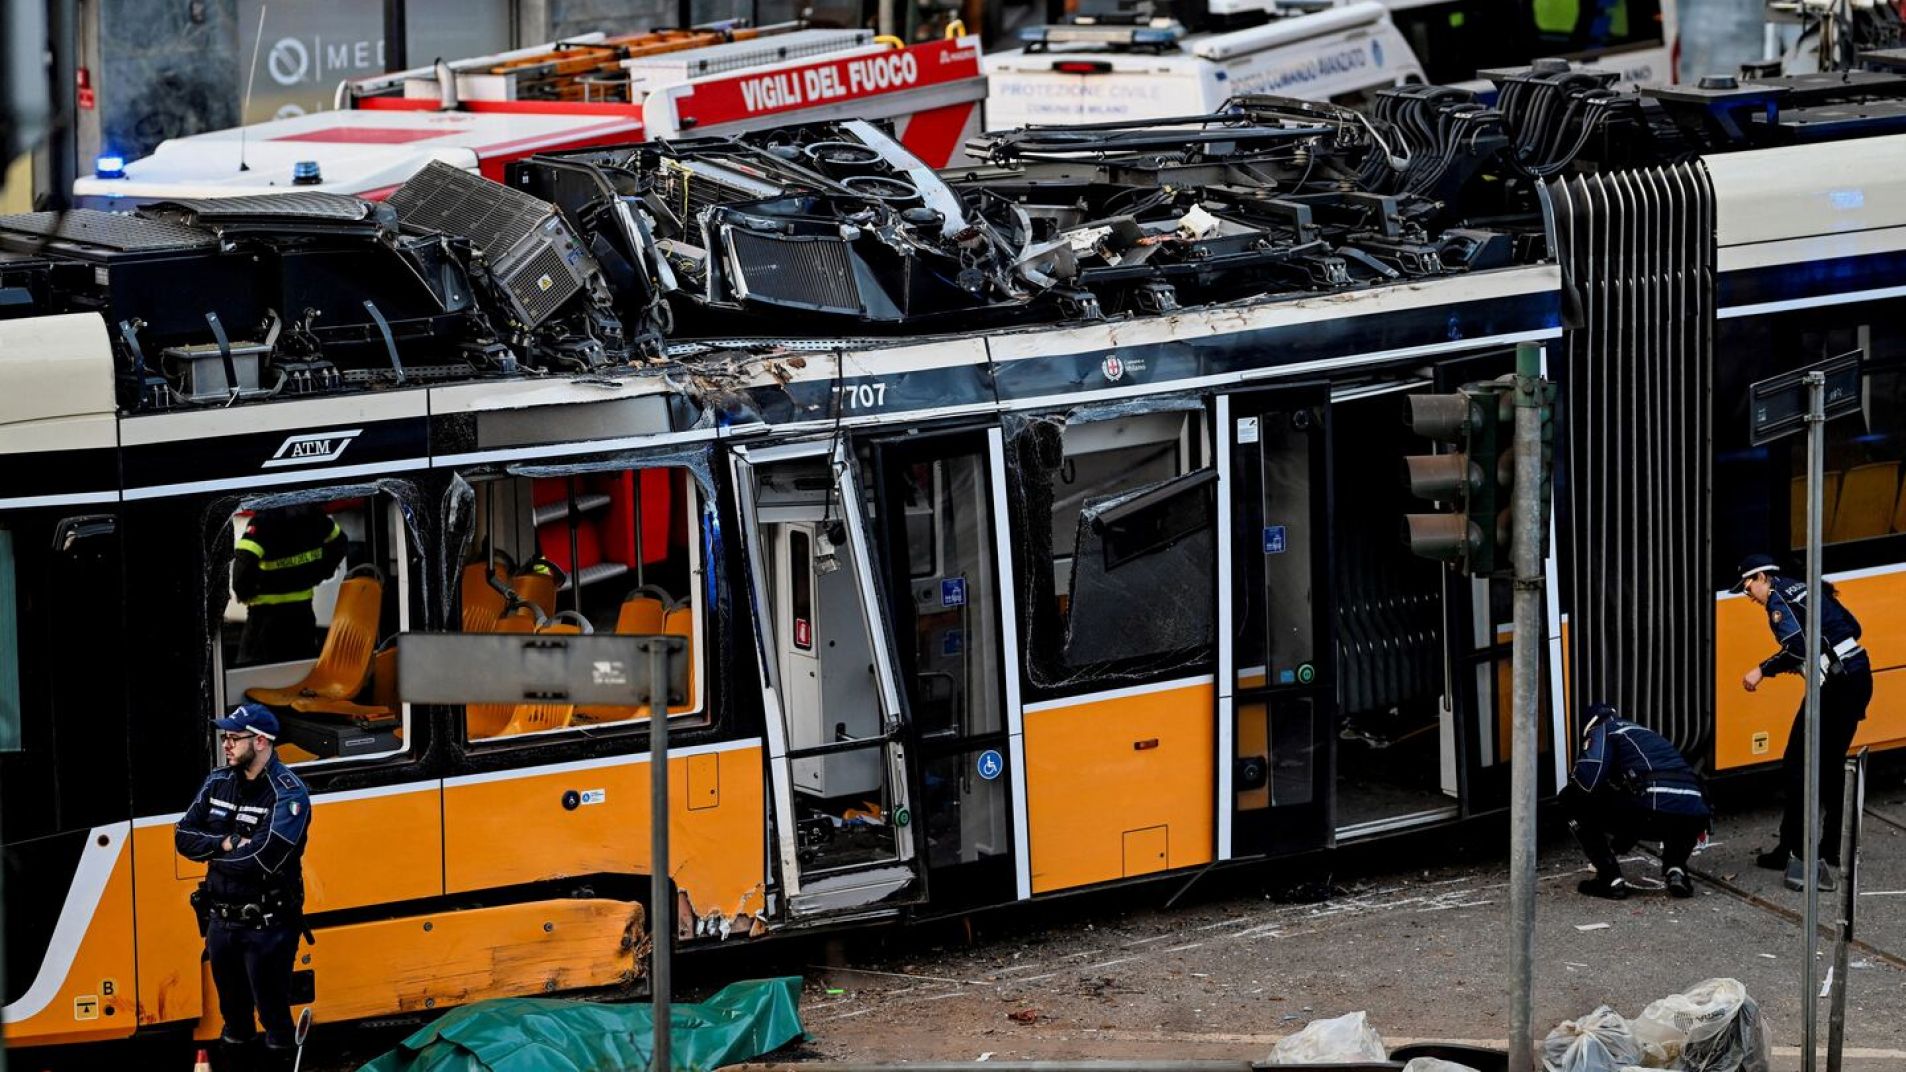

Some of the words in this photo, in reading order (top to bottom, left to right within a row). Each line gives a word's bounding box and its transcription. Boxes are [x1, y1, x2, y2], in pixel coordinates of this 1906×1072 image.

[740, 72, 802, 112] VIGILI
[803, 64, 847, 101] DEL
[847, 51, 918, 94] FUOCO
[1000, 82, 1104, 98] PROTEZIONE
[1109, 84, 1161, 100] CIVILE
[290, 440, 332, 458] ATM
[103, 981, 115, 996] B
